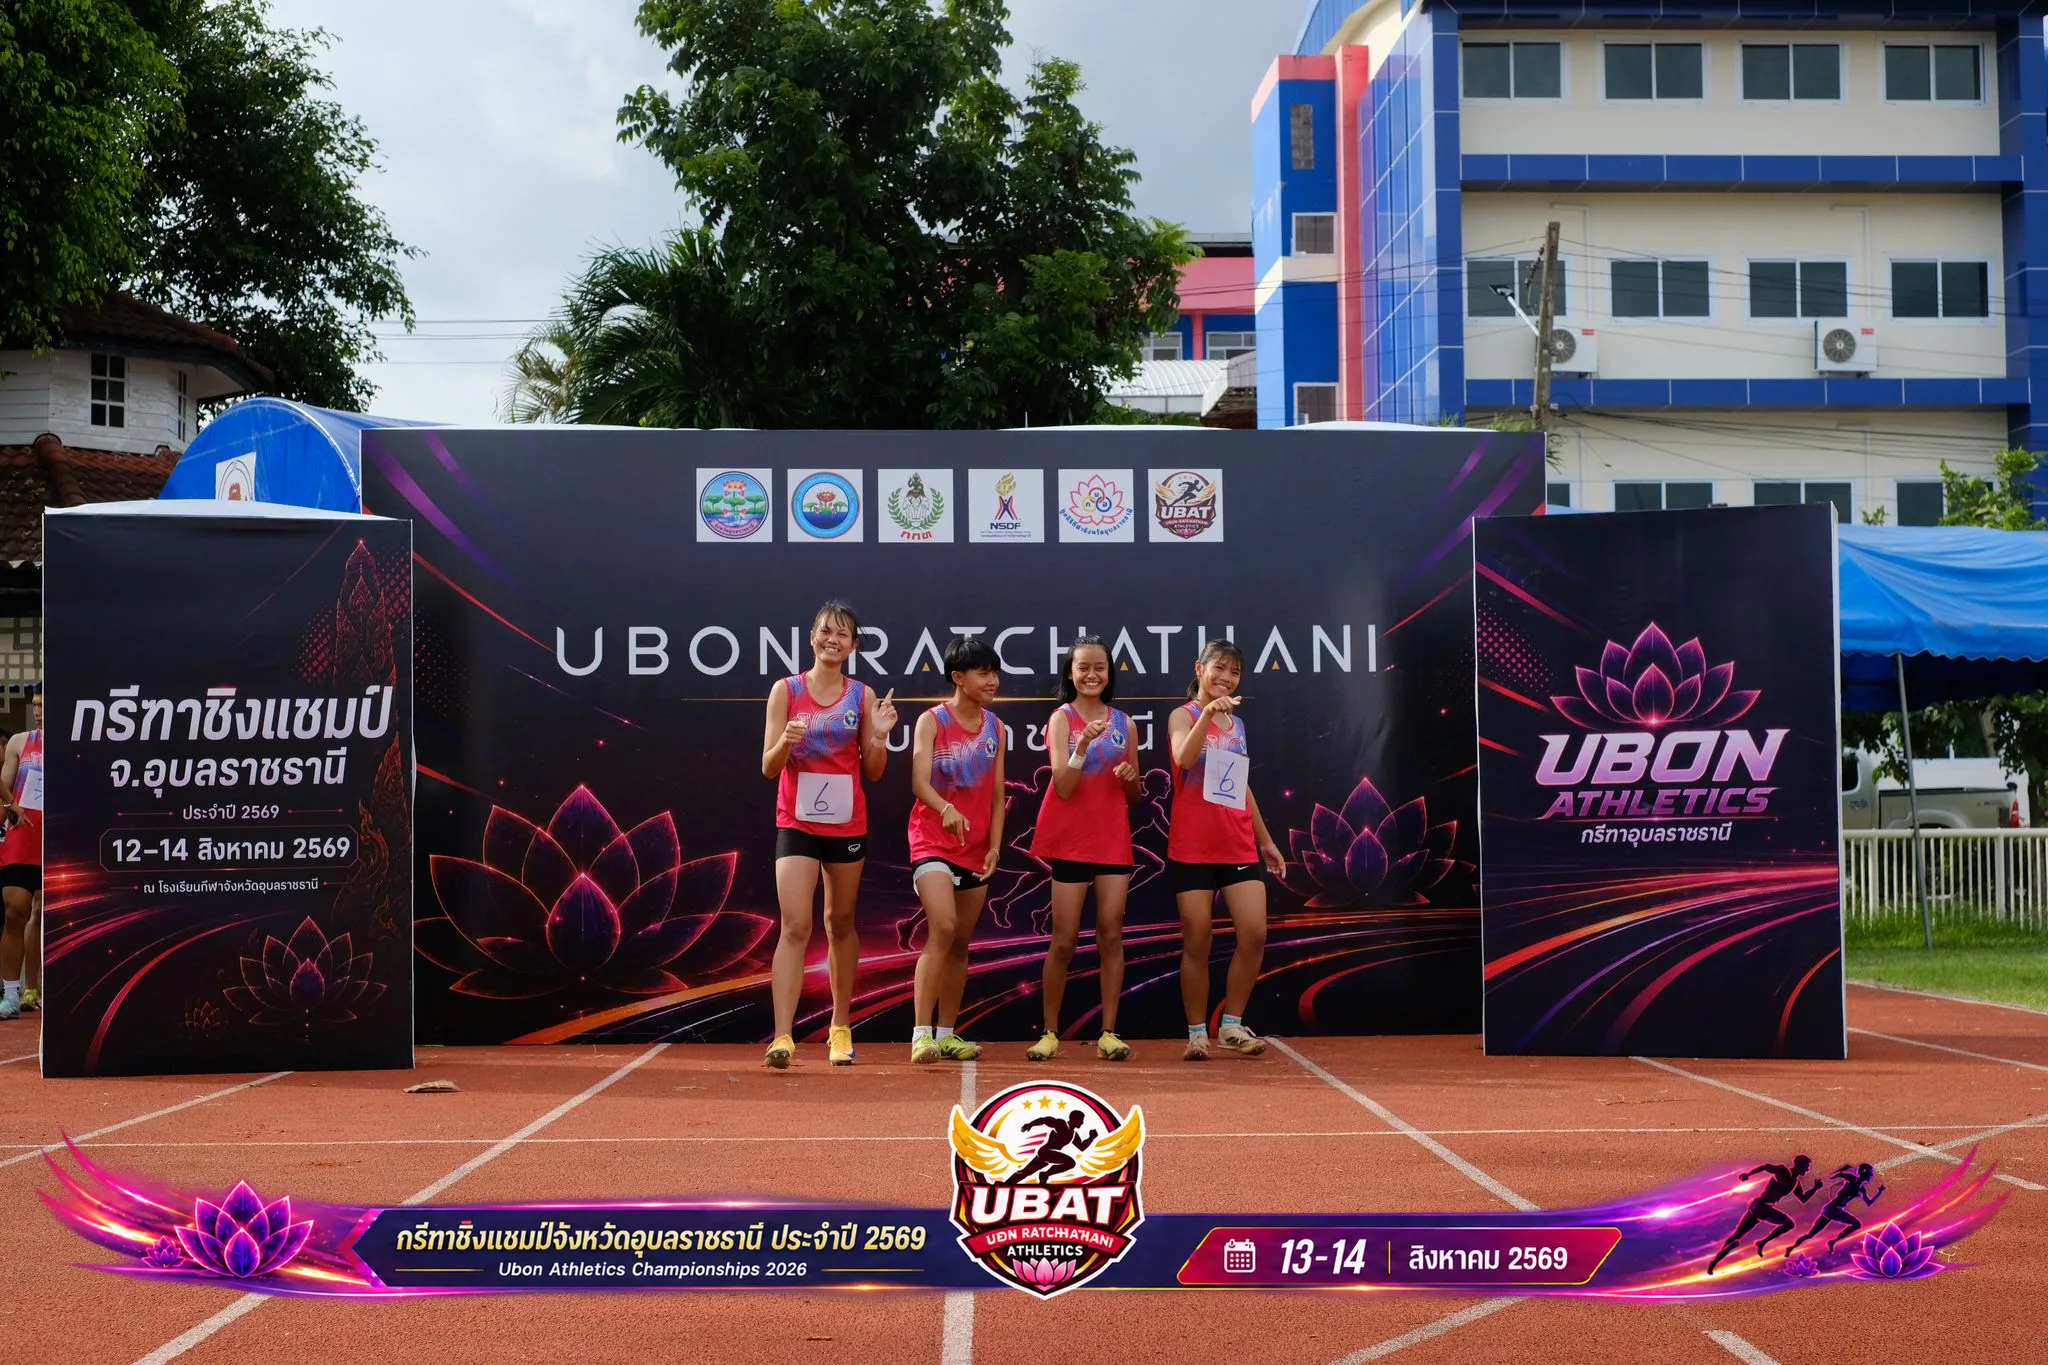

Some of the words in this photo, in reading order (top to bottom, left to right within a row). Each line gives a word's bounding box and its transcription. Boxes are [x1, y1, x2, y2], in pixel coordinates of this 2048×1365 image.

[990, 522, 1021, 530] NSDF
[1160, 506, 1212, 519] UBAT
[900, 530, 933, 541] กกท
[556, 625, 800, 677] UBON
[70, 684, 394, 742] กรีฑาชิงแชมป์
[1535, 728, 1791, 786] UBON
[110, 746, 347, 798] จ.อุบลราชธานี
[1219, 760, 1235, 793] 6
[813, 782, 830, 812] 6
[1537, 787, 1780, 820] ATHLETICS
[182, 803, 236, 820] ประจำปี
[241, 804, 280, 819] 2569
[198, 837, 285, 861] สิงหาคม
[292, 836, 351, 860] 2569
[1580, 821, 1733, 848] กรีฑาอุบลราชธานี
[143, 883, 156, 894] ณ
